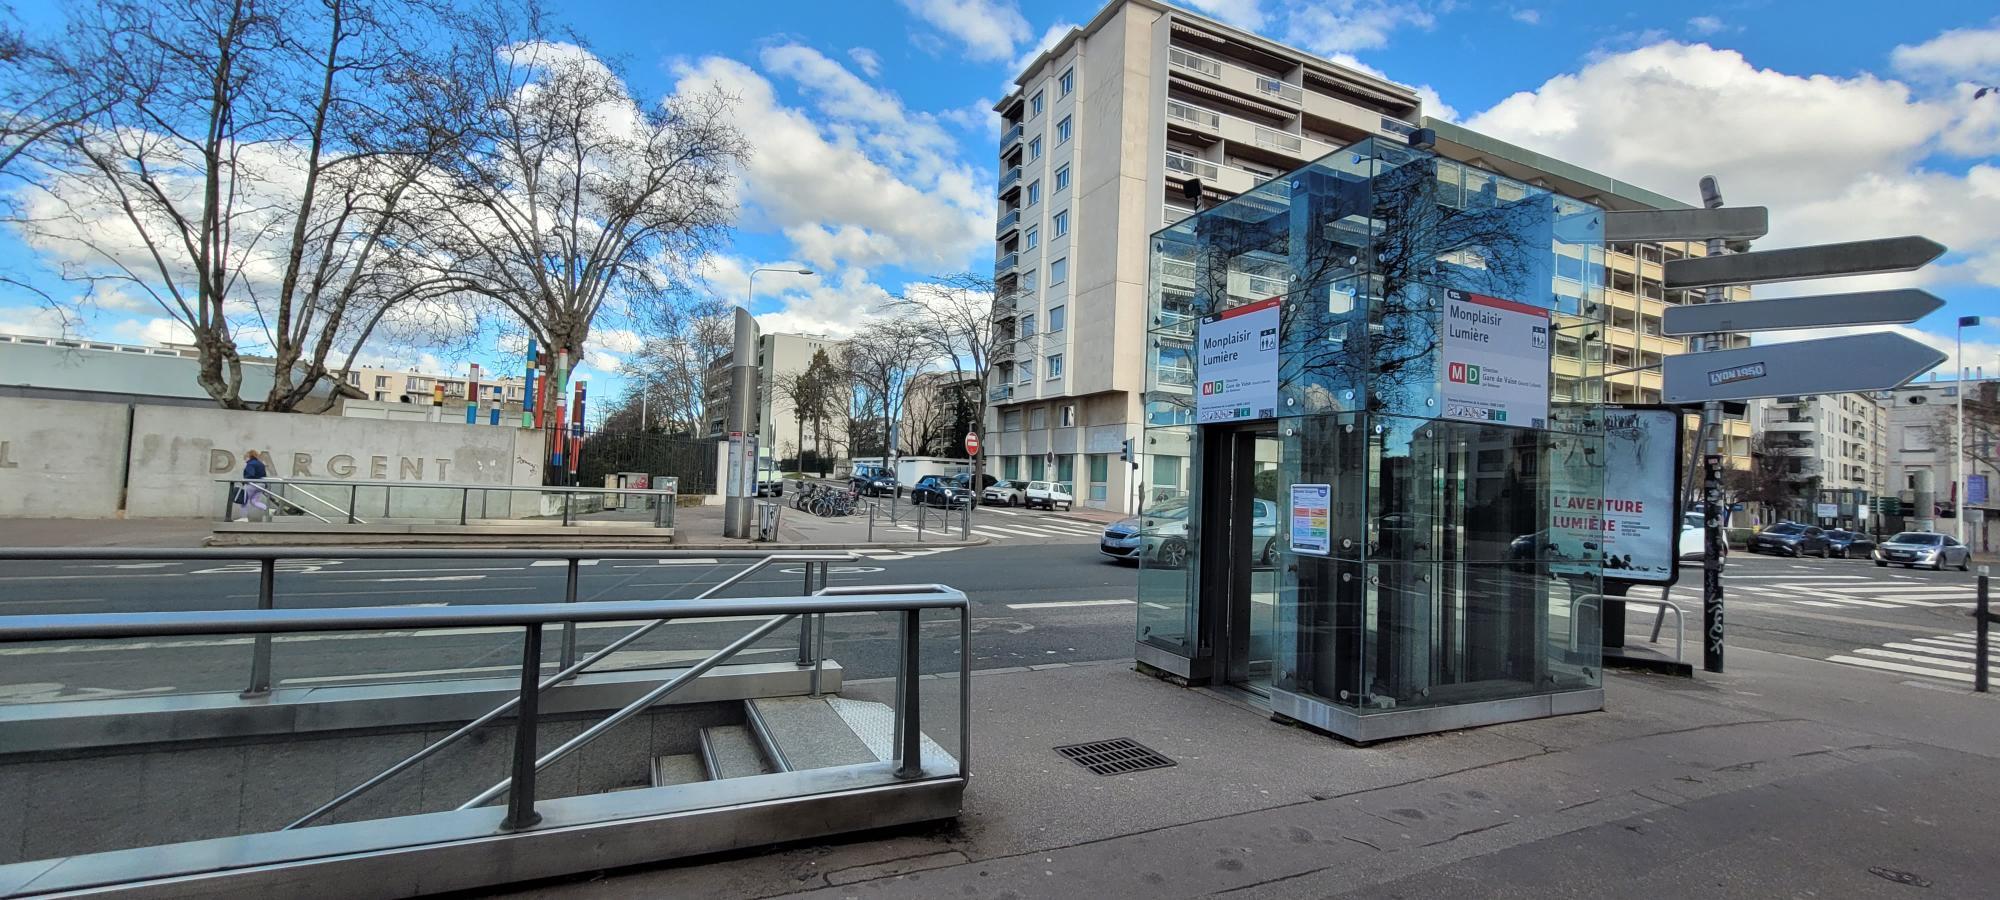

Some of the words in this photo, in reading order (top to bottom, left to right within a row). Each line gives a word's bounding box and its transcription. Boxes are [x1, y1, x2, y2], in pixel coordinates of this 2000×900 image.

[1450, 304, 1502, 326] Monplaisir
[1203, 329, 1251, 350] Monplaisir
[1449, 324, 1489, 343] Lumière
[1203, 350, 1239, 366] Lumière
[1451, 364, 1464, 381] M
[1468, 366, 1478, 382] D
[1711, 370, 1736, 383] LYON
[1737, 365, 1763, 377] 1950
[1204, 383, 1212, 395] M
[1215, 381, 1222, 394] D
[1553, 515, 1616, 532] LUMIÈRE
